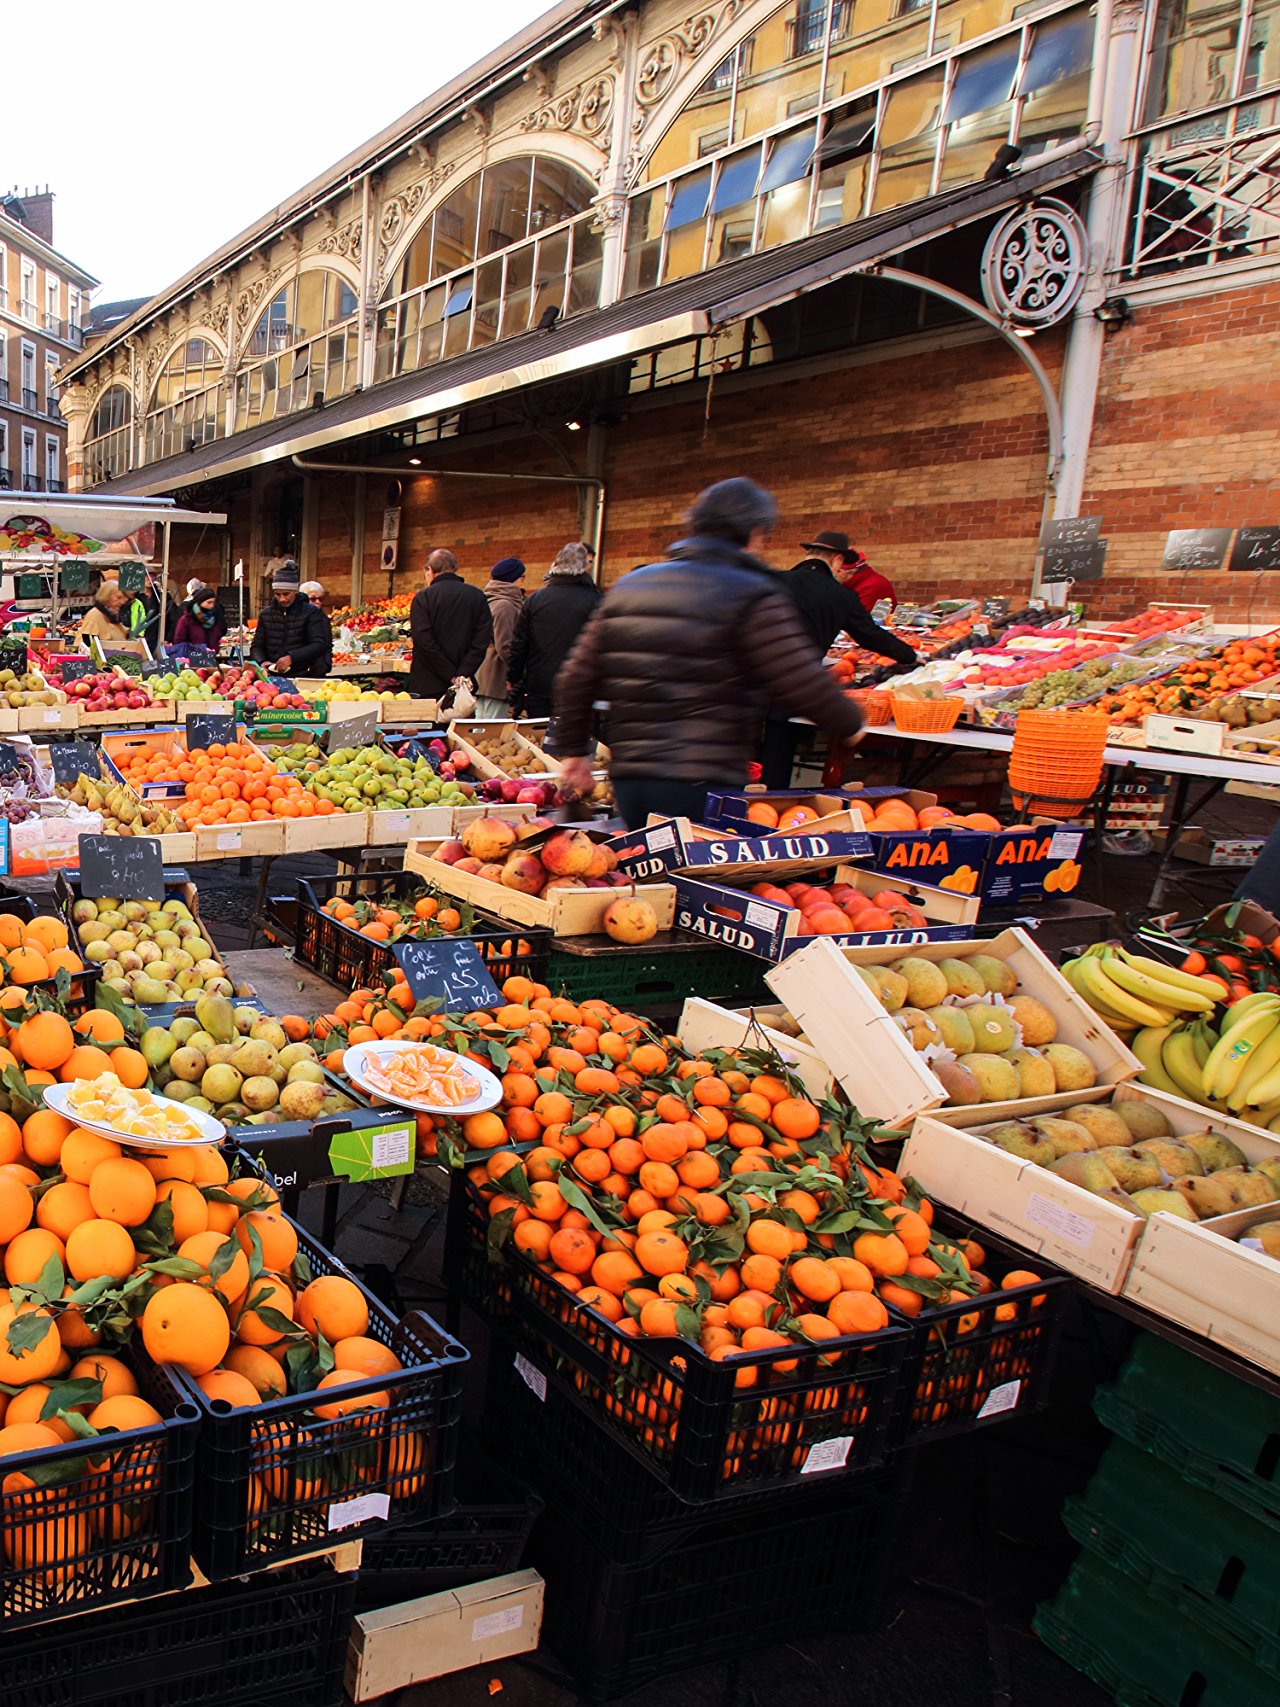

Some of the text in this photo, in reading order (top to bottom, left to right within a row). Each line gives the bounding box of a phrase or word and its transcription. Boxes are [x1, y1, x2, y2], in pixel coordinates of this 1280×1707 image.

[260, 711, 302, 720] minervoise
[710, 836, 830, 865] SALUD
[624, 857, 665, 880] LUD
[679, 911, 755, 950] SALUD
[837, 931, 929, 946] ALUD
[274, 1171, 297, 1187] bel
